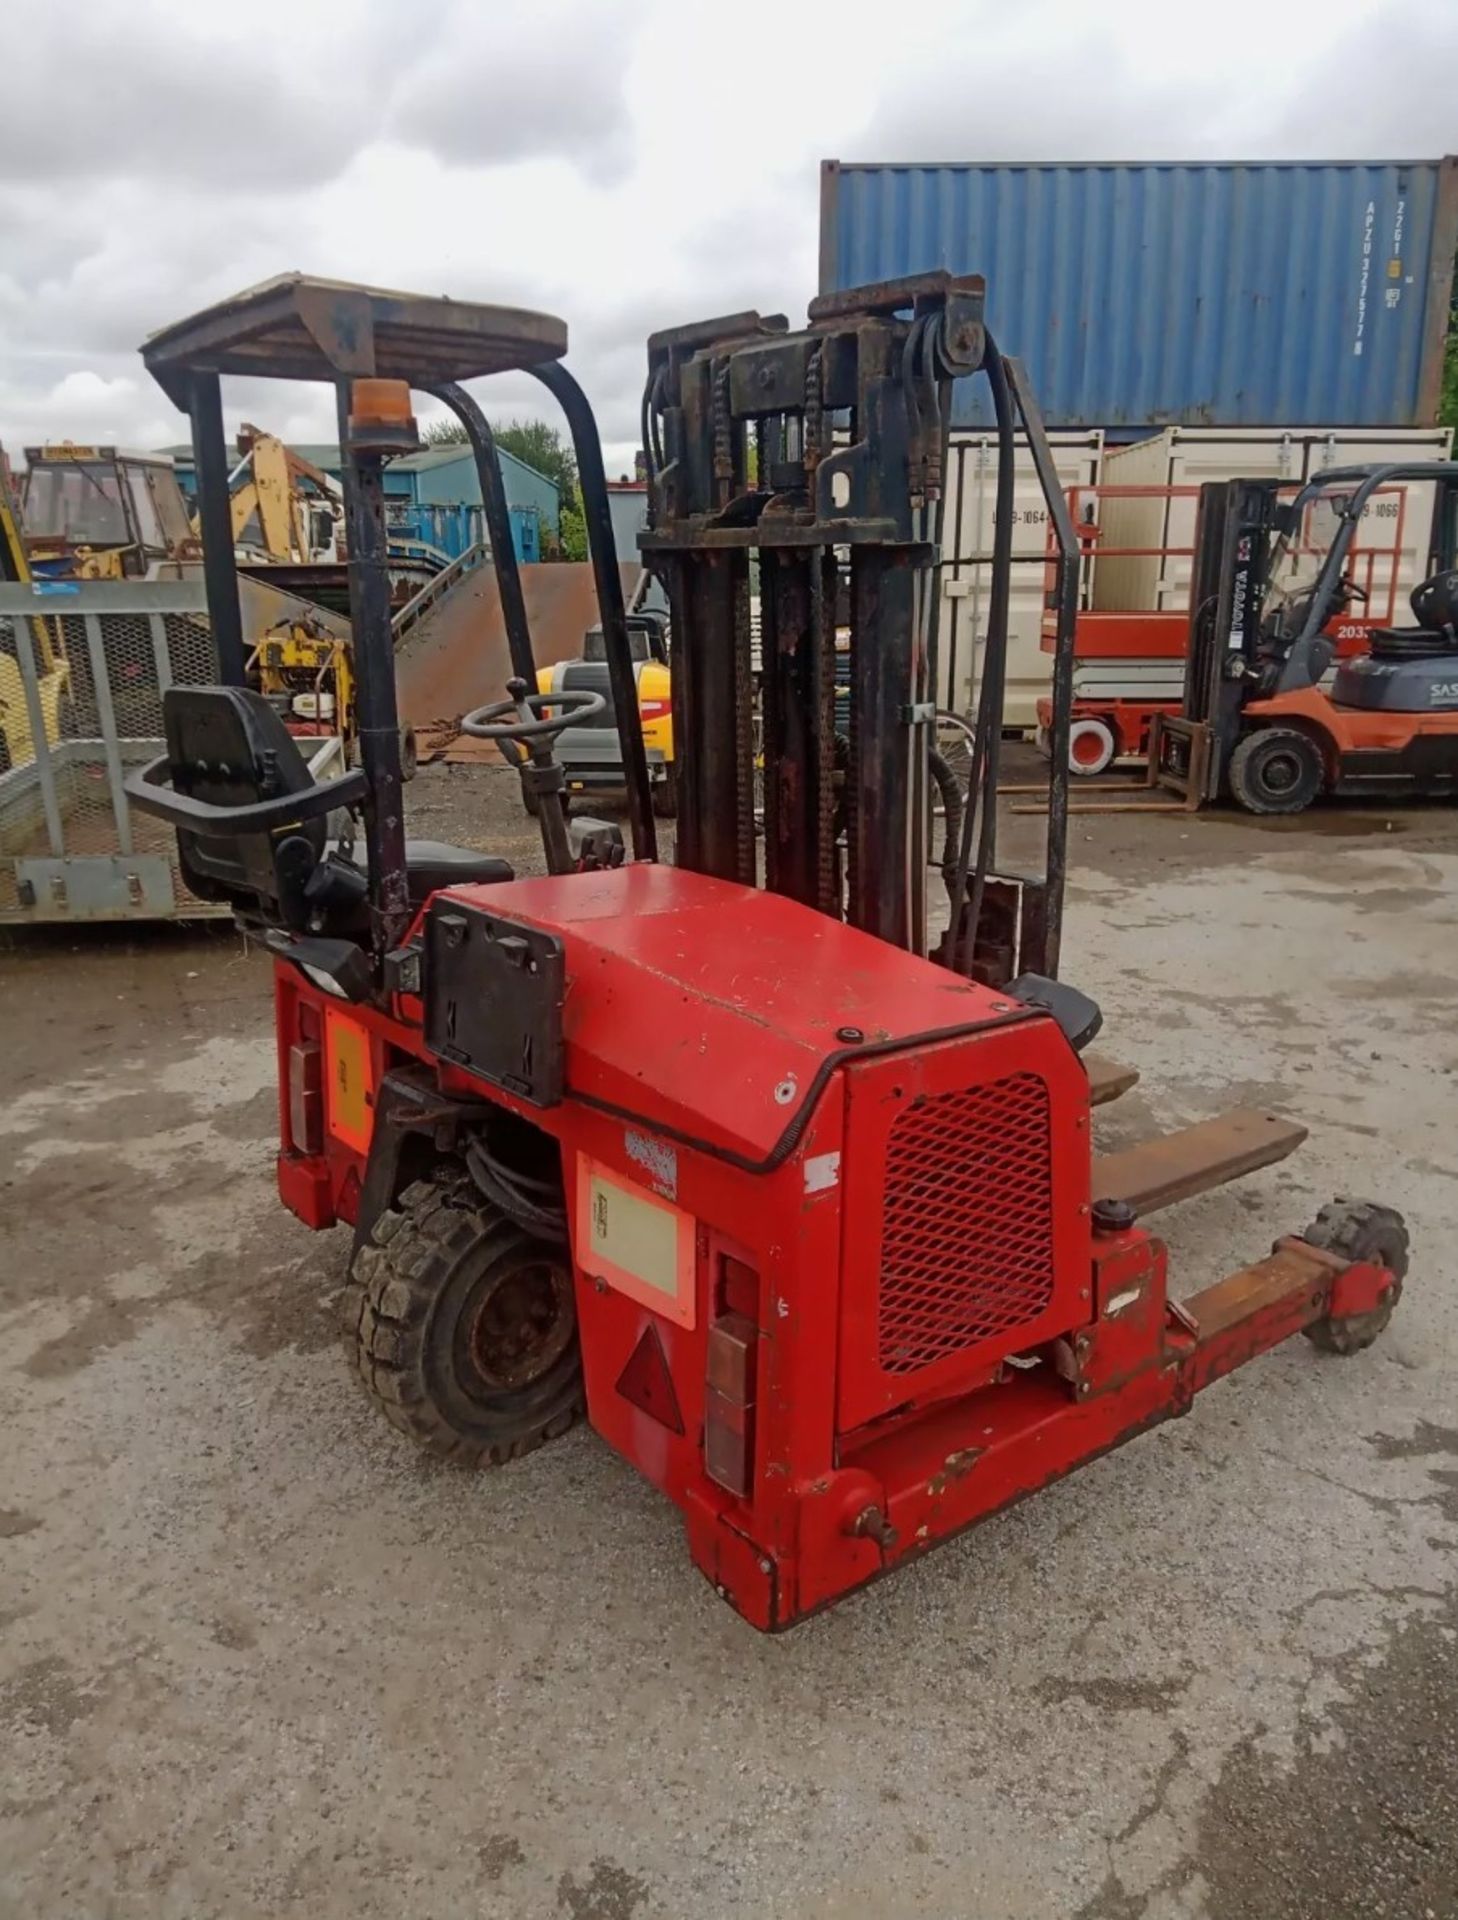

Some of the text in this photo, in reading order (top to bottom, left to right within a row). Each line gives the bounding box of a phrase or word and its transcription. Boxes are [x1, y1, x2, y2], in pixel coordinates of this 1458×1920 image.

[1363, 201, 1375, 254] APZU
[1394, 201, 1404, 254] 22G1
[1361, 503, 1399, 517] 9-1066
[1231, 570, 1248, 631] TOYOTA
